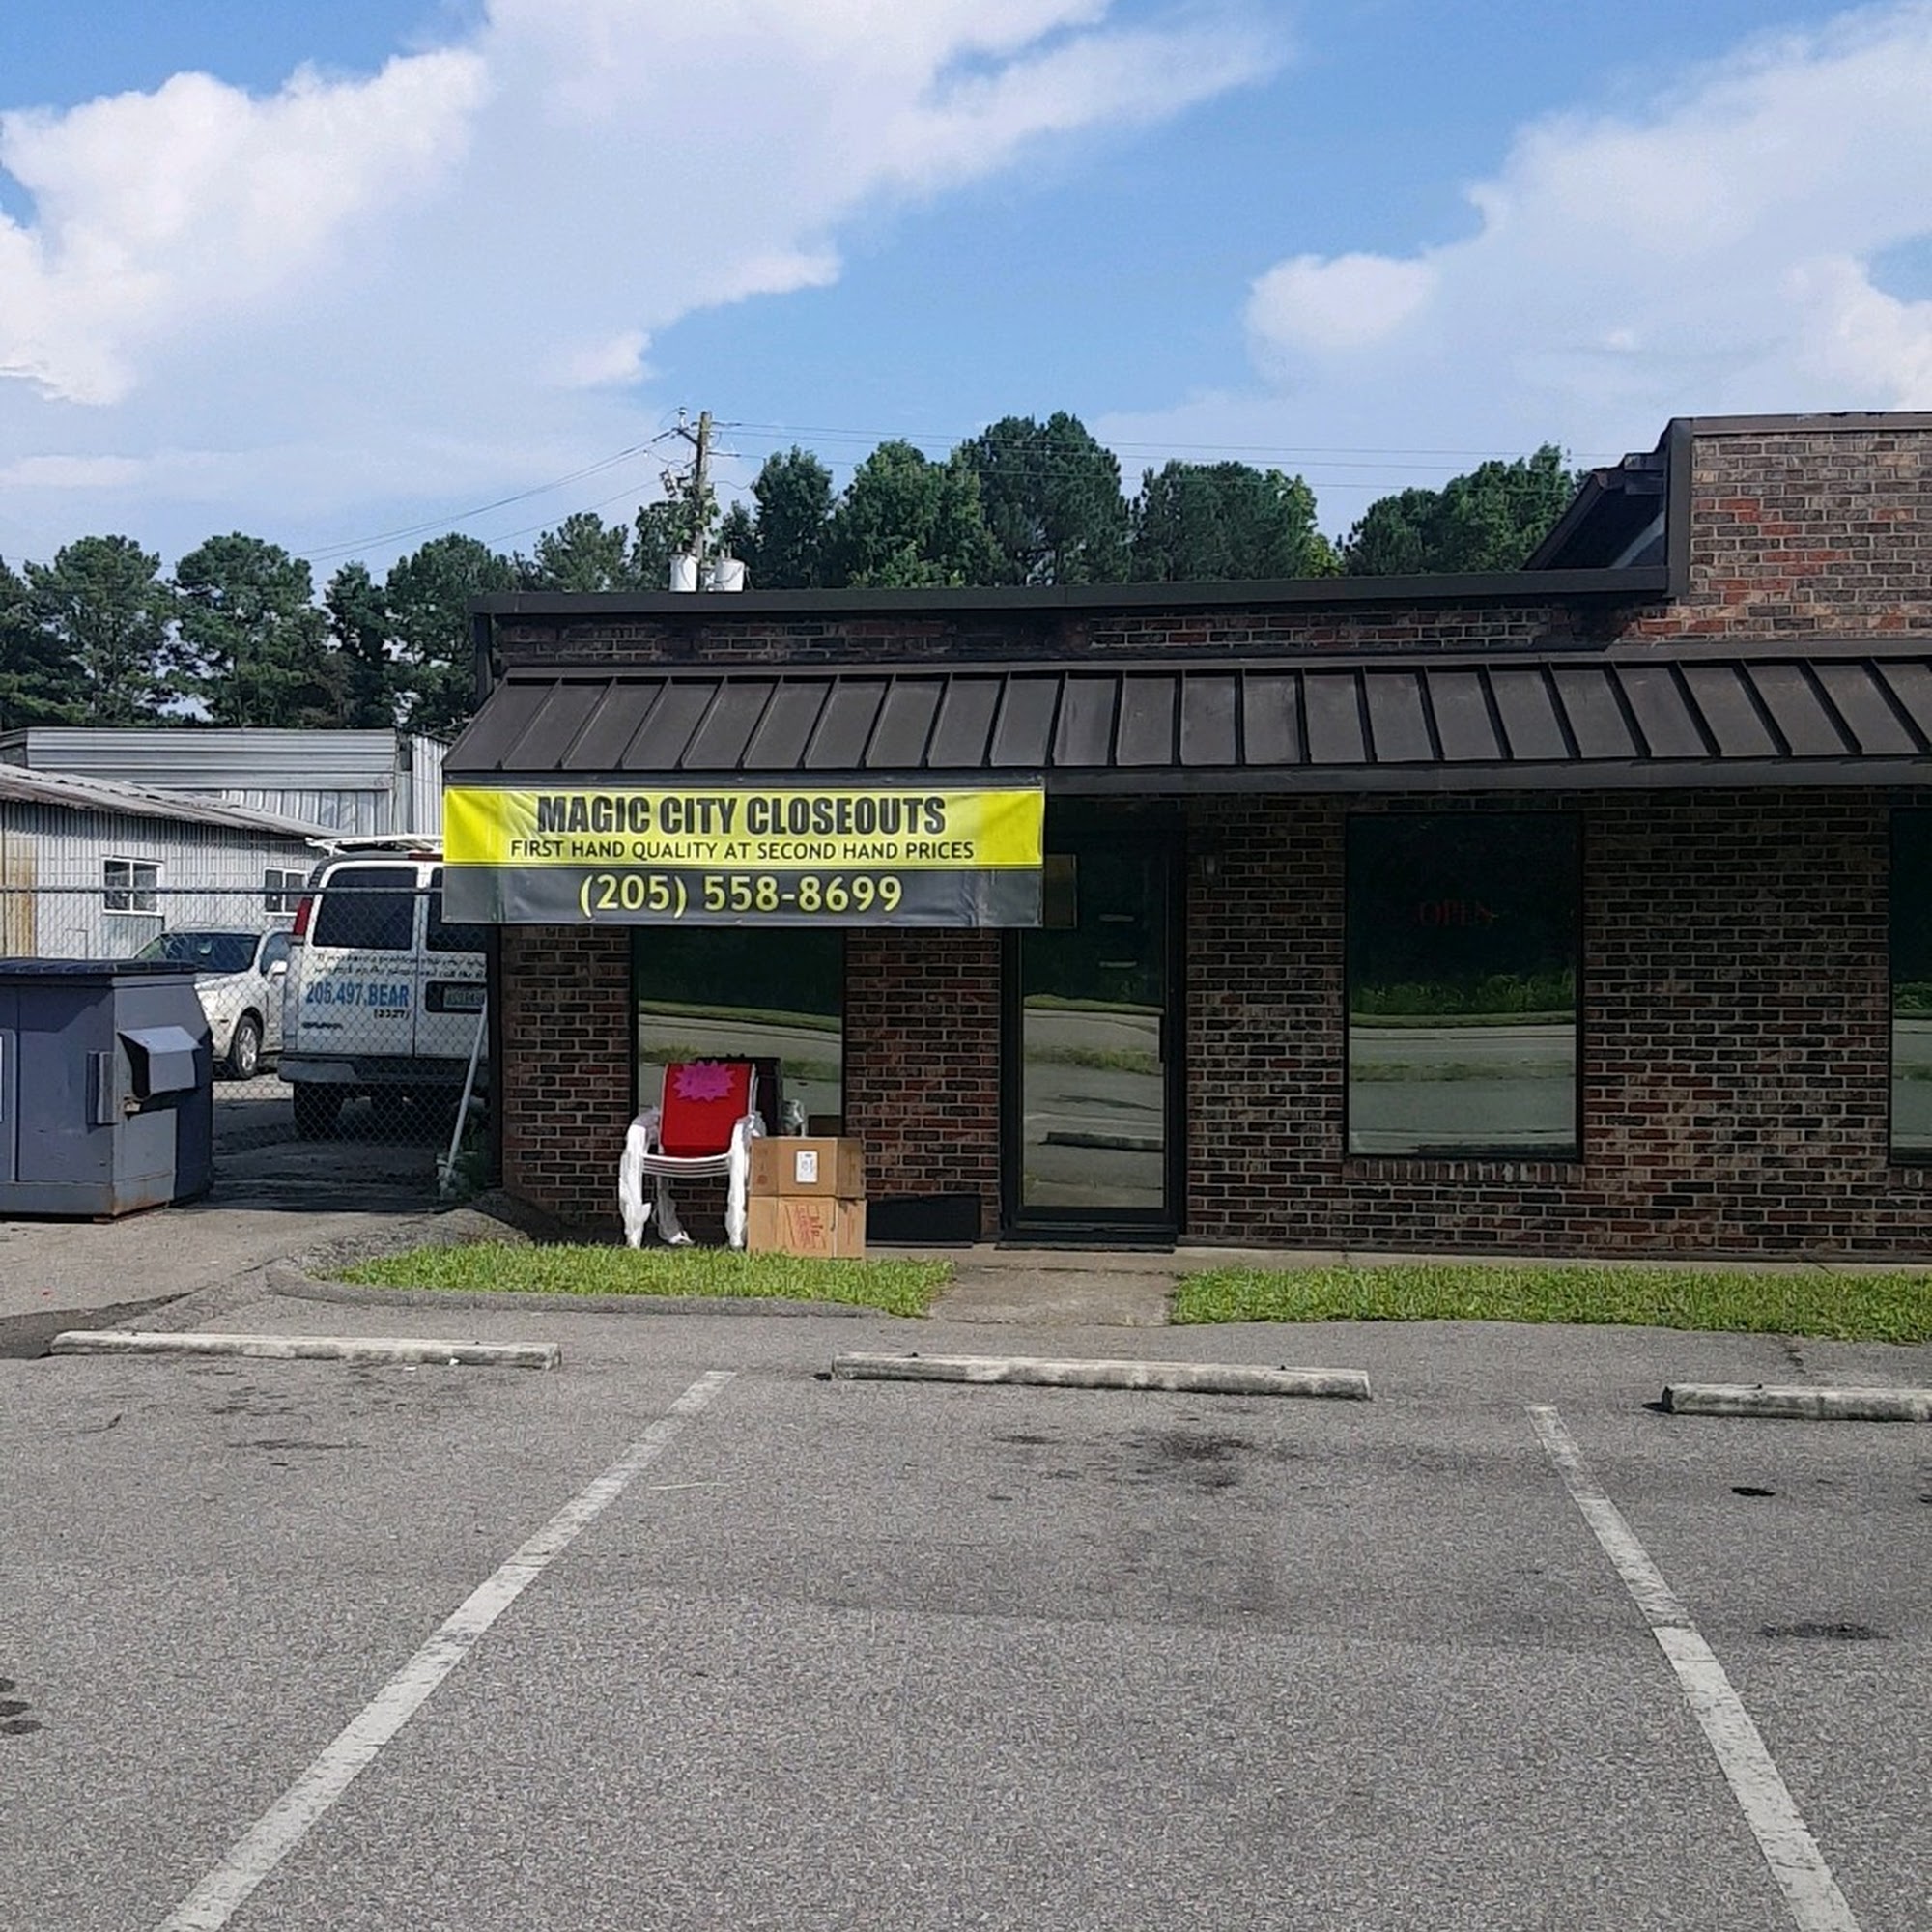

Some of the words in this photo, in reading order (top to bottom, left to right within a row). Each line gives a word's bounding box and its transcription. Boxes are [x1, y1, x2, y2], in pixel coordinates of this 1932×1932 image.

[537, 796, 650, 833] MAGIC
[660, 797, 737, 835] CITY
[747, 797, 946, 836] CLOSEOUTS
[511, 839, 564, 858] FIRST
[572, 841, 625, 858] HAND
[632, 841, 718, 861] QUALITY
[724, 842, 751, 859] AT
[757, 842, 836, 860] SECOND
[843, 842, 898, 860] HAND
[906, 841, 974, 860] PRICES
[580, 873, 688, 919] (205)
[704, 875, 902, 913] 558-8699
